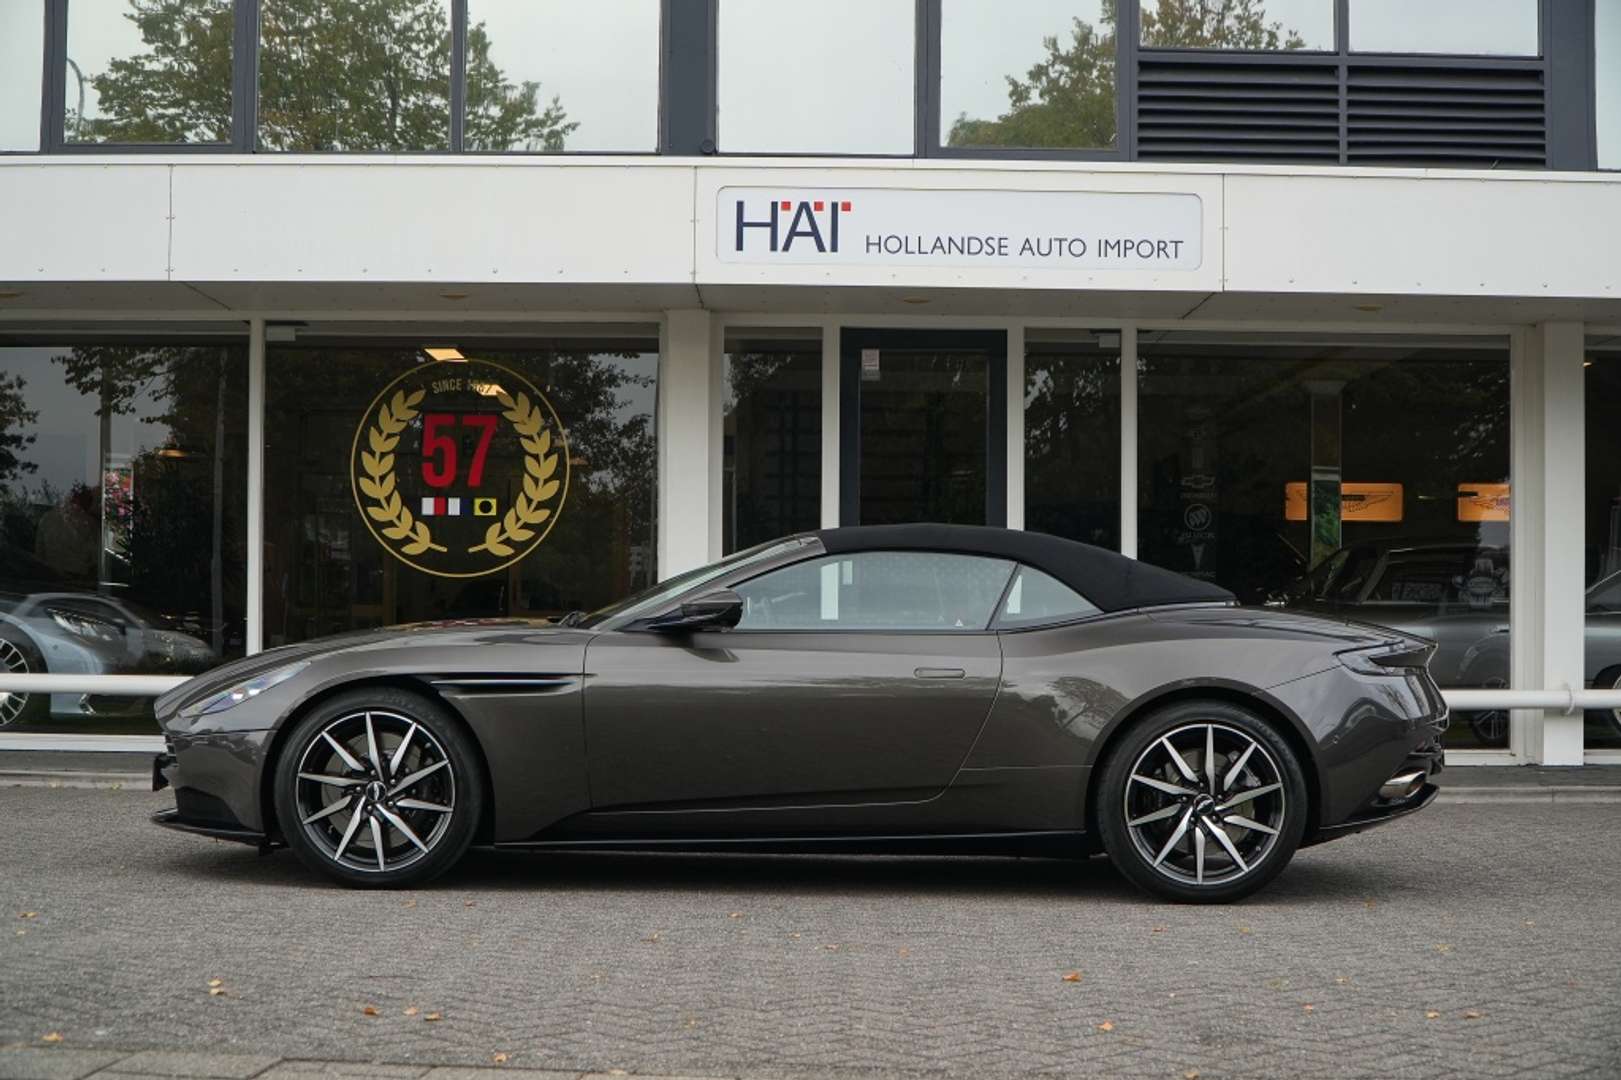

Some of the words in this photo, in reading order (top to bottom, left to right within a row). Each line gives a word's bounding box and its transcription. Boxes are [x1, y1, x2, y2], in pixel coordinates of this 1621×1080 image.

[865, 235, 1009, 257] HOLLANDSE
[1019, 238, 1087, 259] AUTO
[1098, 239, 1184, 260] IMPORT
[432, 378, 463, 394] SINCE
[422, 414, 498, 488] 57
